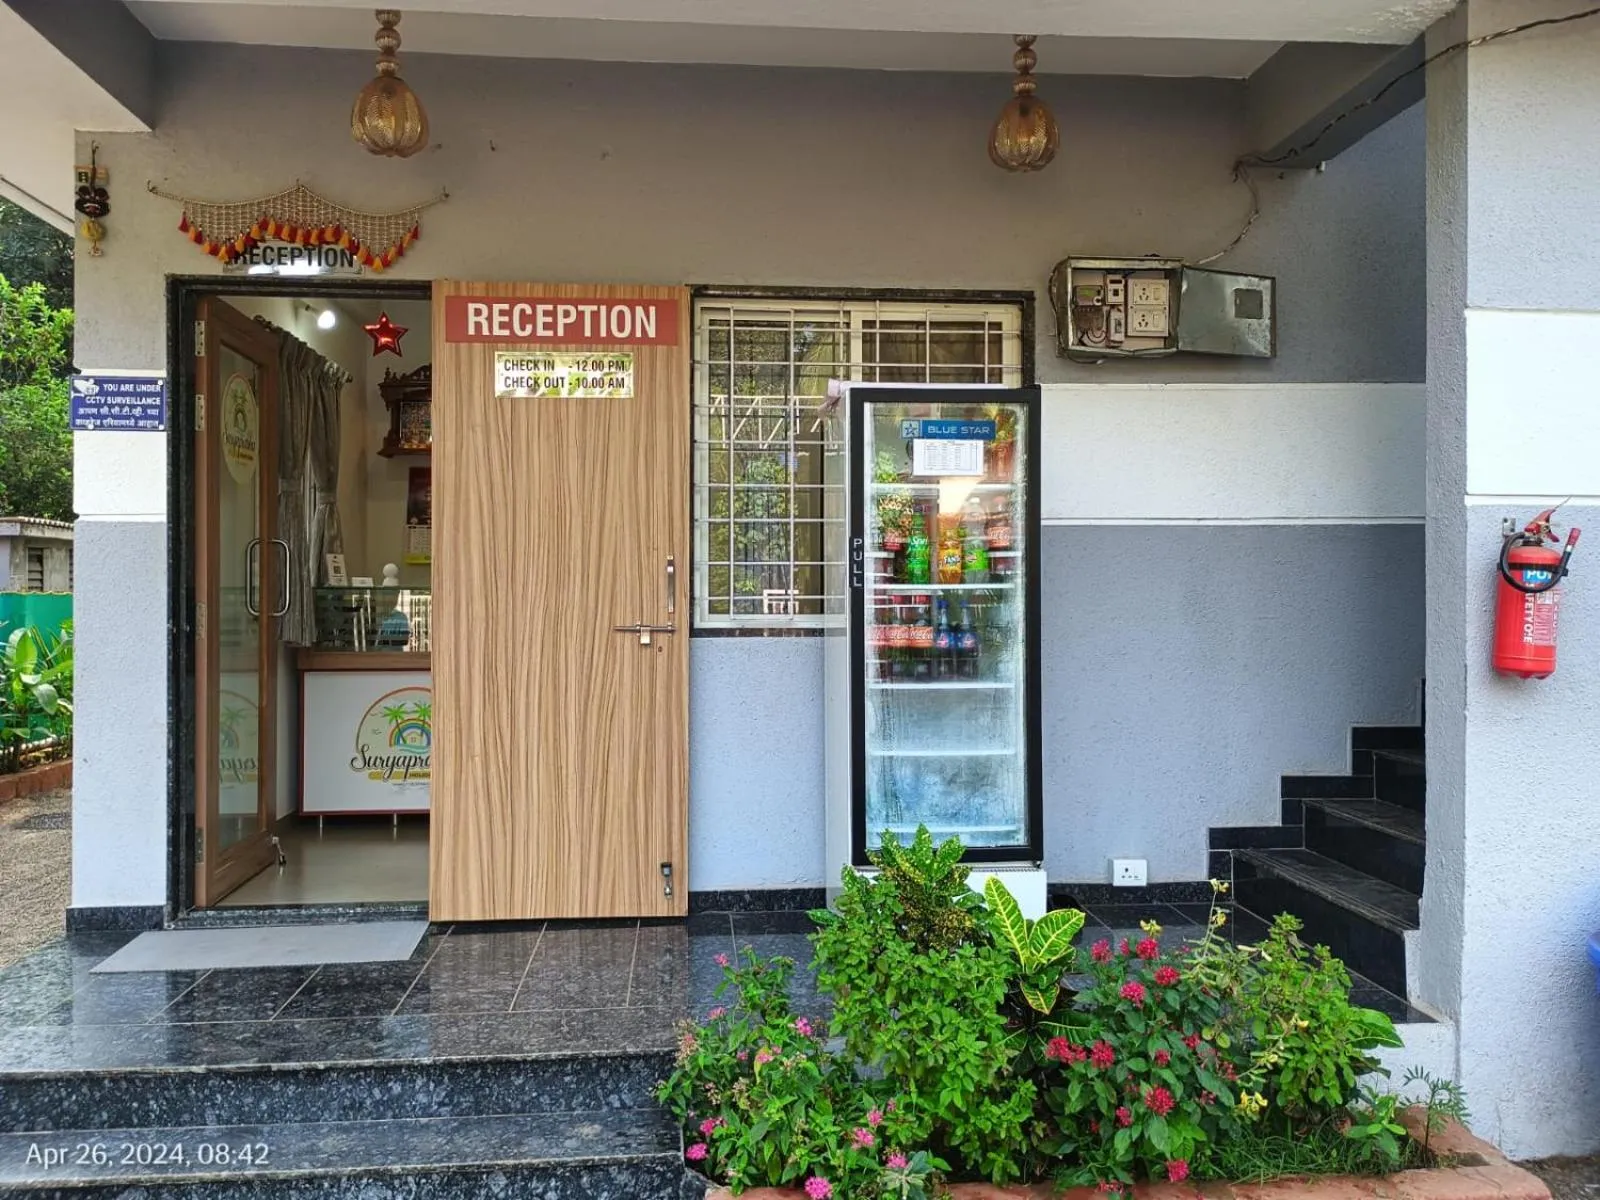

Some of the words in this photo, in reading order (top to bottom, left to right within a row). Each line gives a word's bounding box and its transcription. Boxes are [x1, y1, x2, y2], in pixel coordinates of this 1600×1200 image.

[234, 245, 354, 268] RECEPTION
[467, 302, 656, 338] RECEPTION
[504, 359, 540, 372] CHECK
[544, 360, 555, 372] IN
[575, 360, 605, 372] 12.00
[608, 361, 625, 373] PM
[103, 384, 118, 392] YOU
[120, 384, 134, 392] ARE
[504, 376, 541, 389] CHECK
[544, 377, 565, 388] OUT
[576, 377, 605, 389] 10.00
[608, 377, 625, 389] AM
[85, 396, 106, 404] CCTV
[107, 396, 160, 405] SURVEILLANCE
[927, 425, 957, 434] BLUE
[960, 426, 990, 434] STAR
[853, 538, 862, 587] PULL
